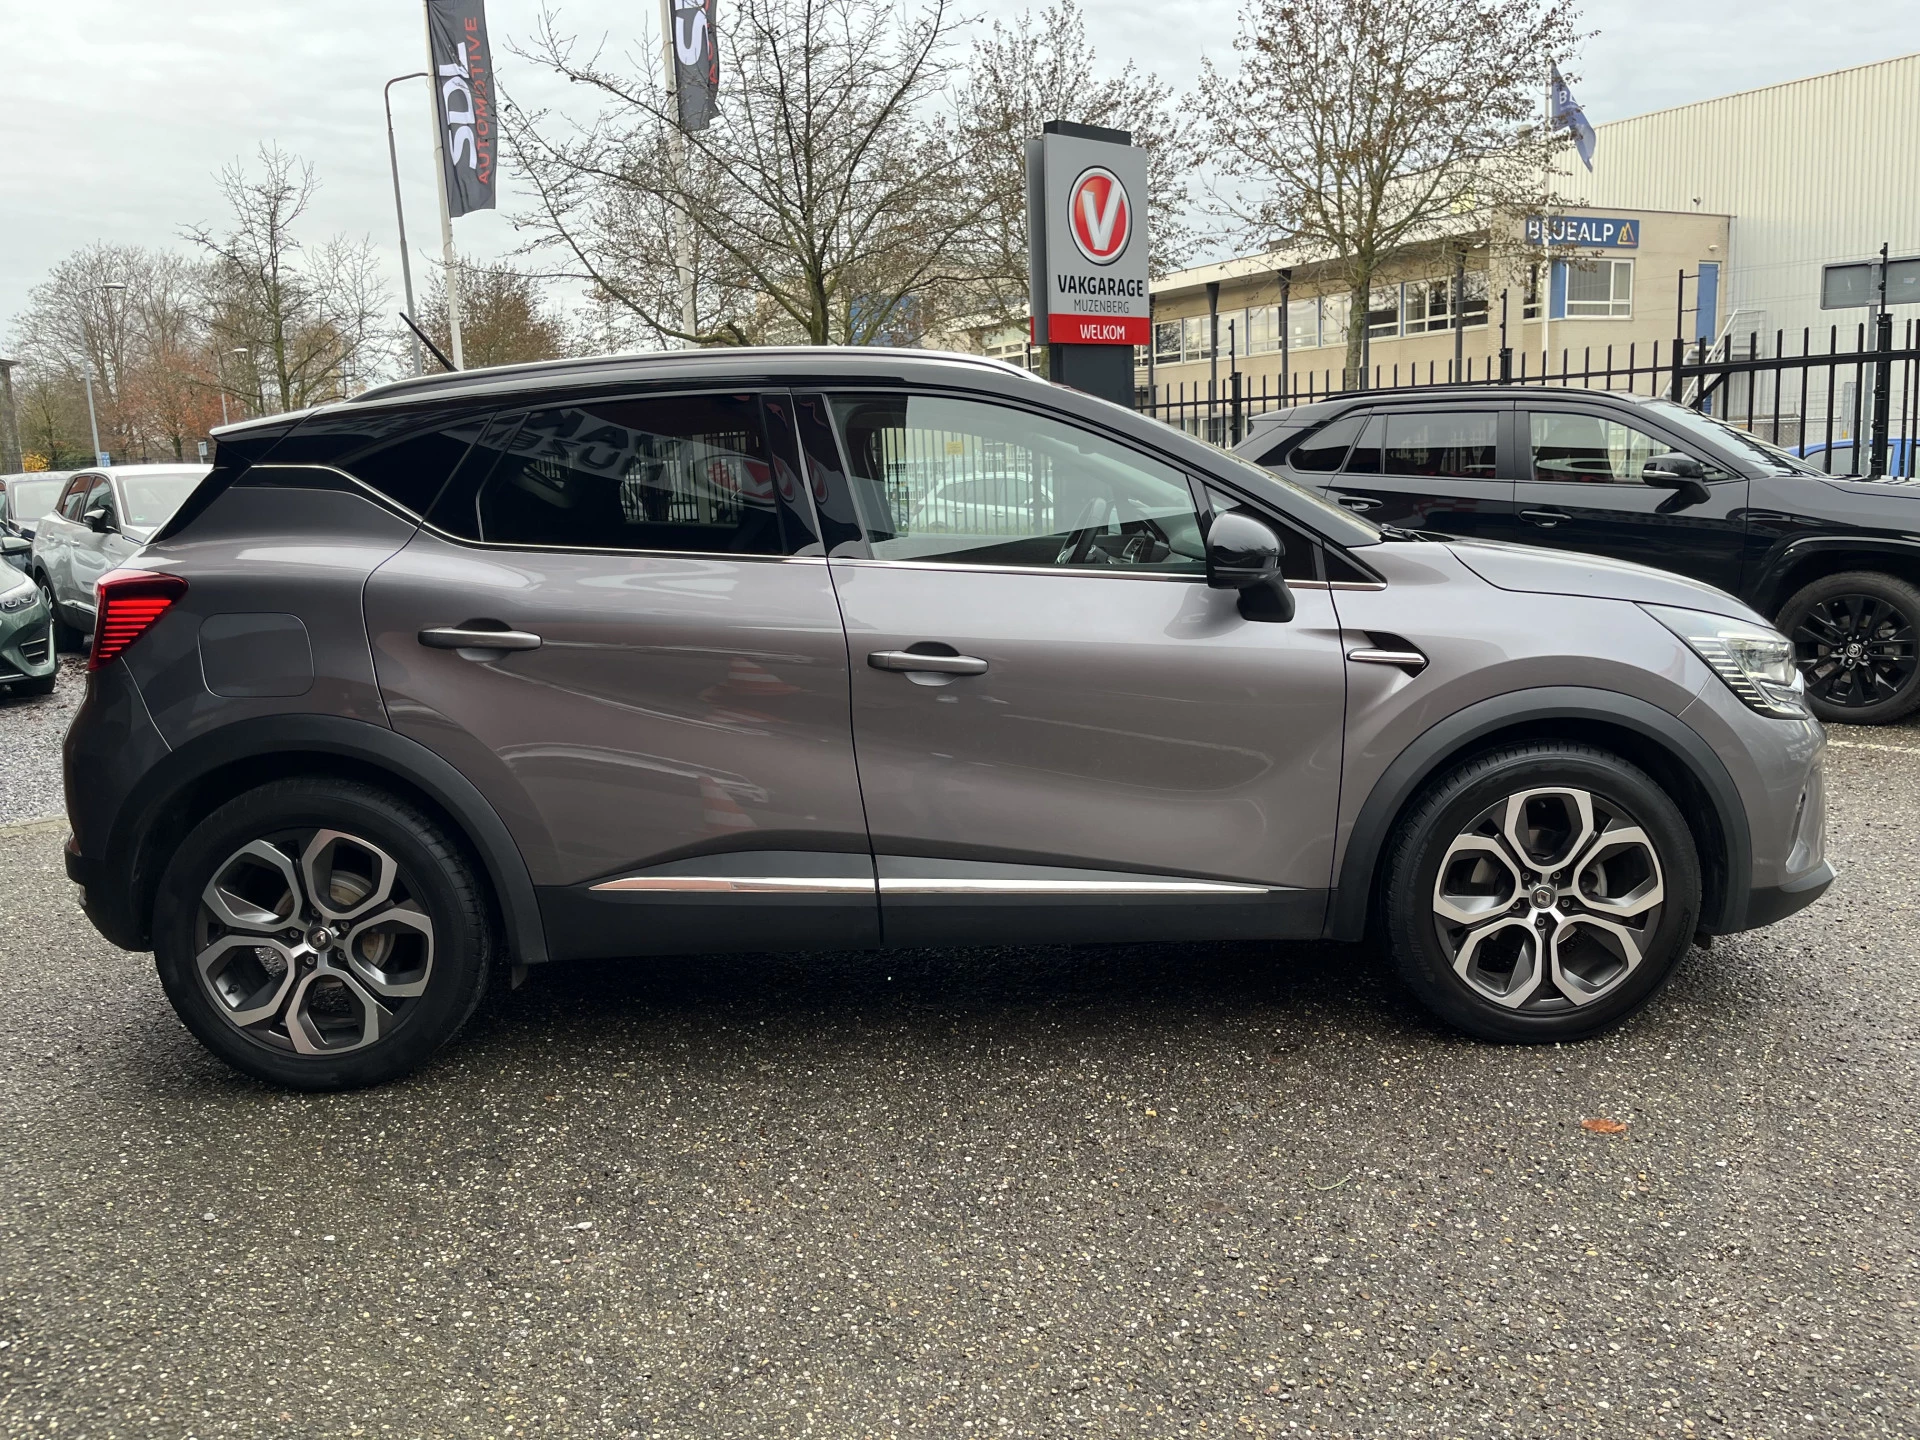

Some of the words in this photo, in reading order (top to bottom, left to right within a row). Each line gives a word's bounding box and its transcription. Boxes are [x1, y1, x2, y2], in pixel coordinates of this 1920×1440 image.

[439, 42, 478, 169] SDL
[464, 16, 491, 184] AUTOMOTIVE
[1057, 274, 1144, 298] VAKGARAGE
[1073, 299, 1130, 314] MUZENBERG
[1079, 323, 1126, 340] WELKOM
